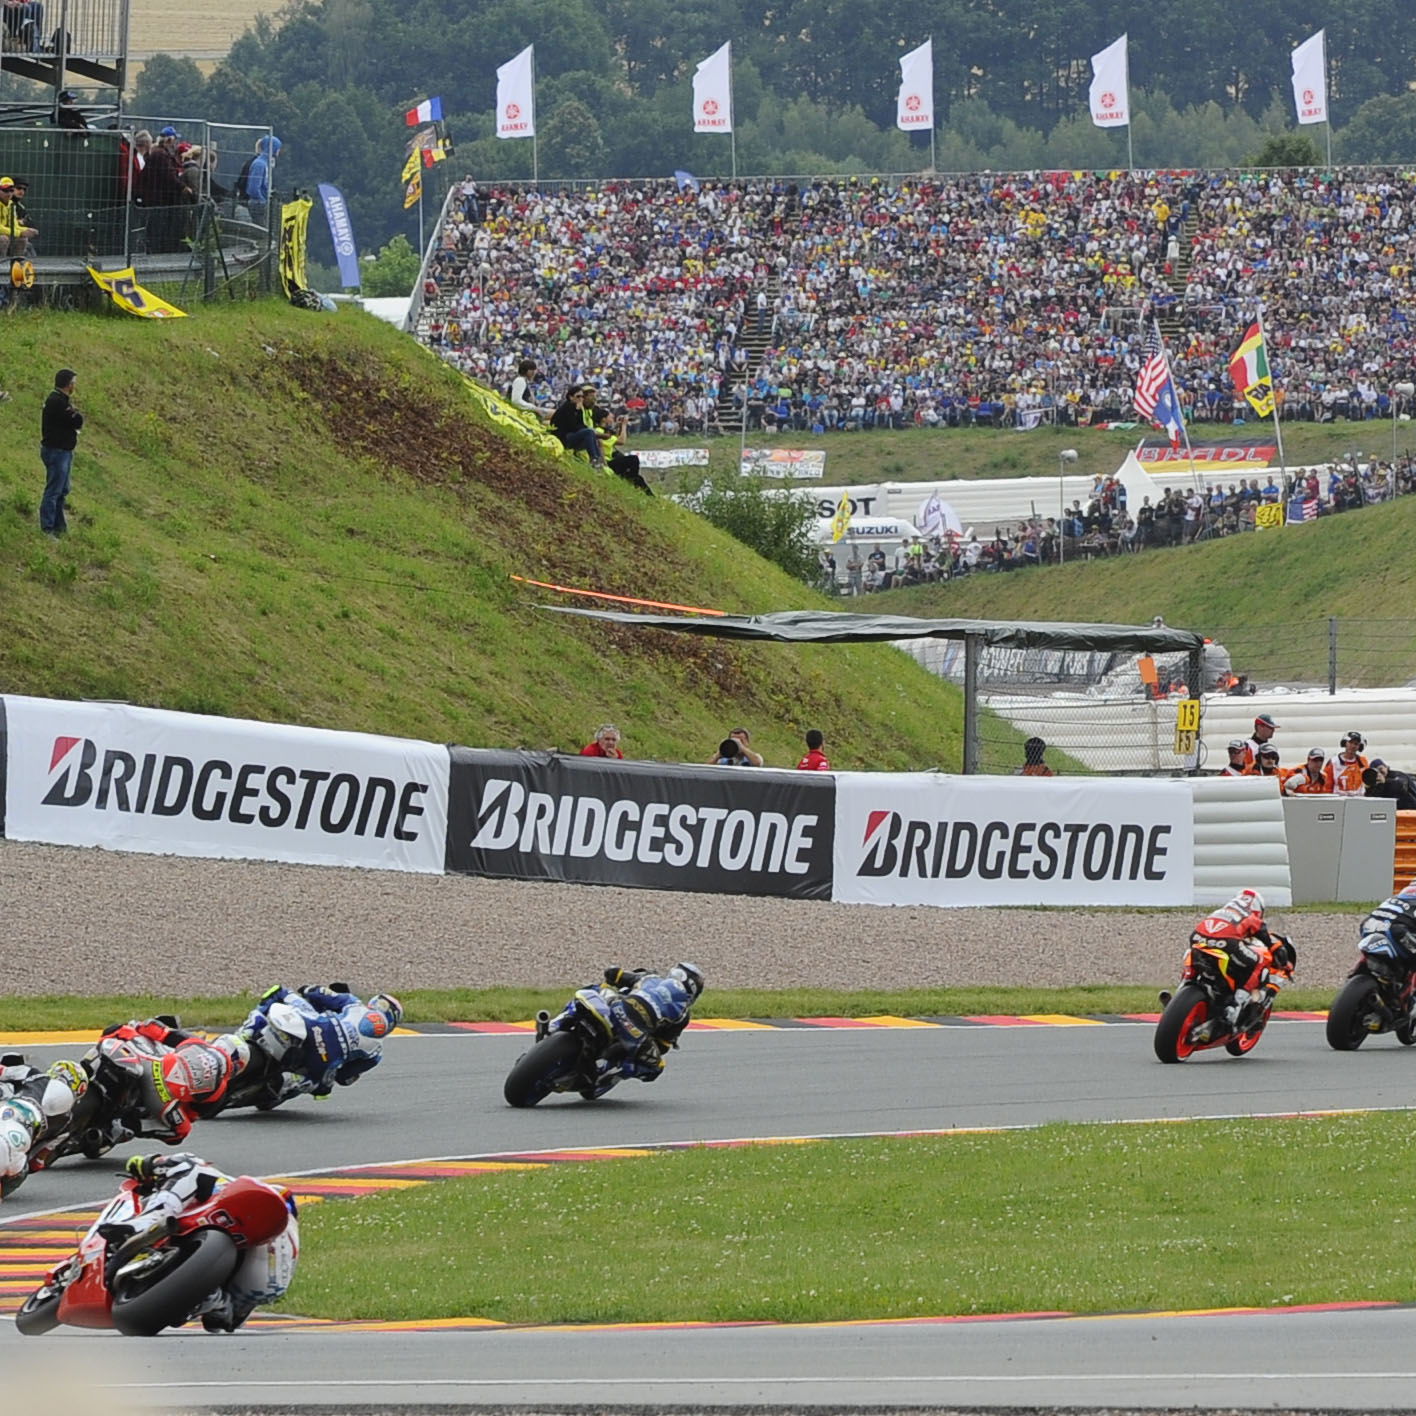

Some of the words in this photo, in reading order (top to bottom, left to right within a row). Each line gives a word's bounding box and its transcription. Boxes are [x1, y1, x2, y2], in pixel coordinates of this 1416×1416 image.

[846, 525, 898, 535] SUZUKI
[42, 736, 428, 842] BRIDGESTONE
[470, 779, 818, 875] BRIDGESTONE
[857, 811, 1172, 882] BRIDGESTONE
